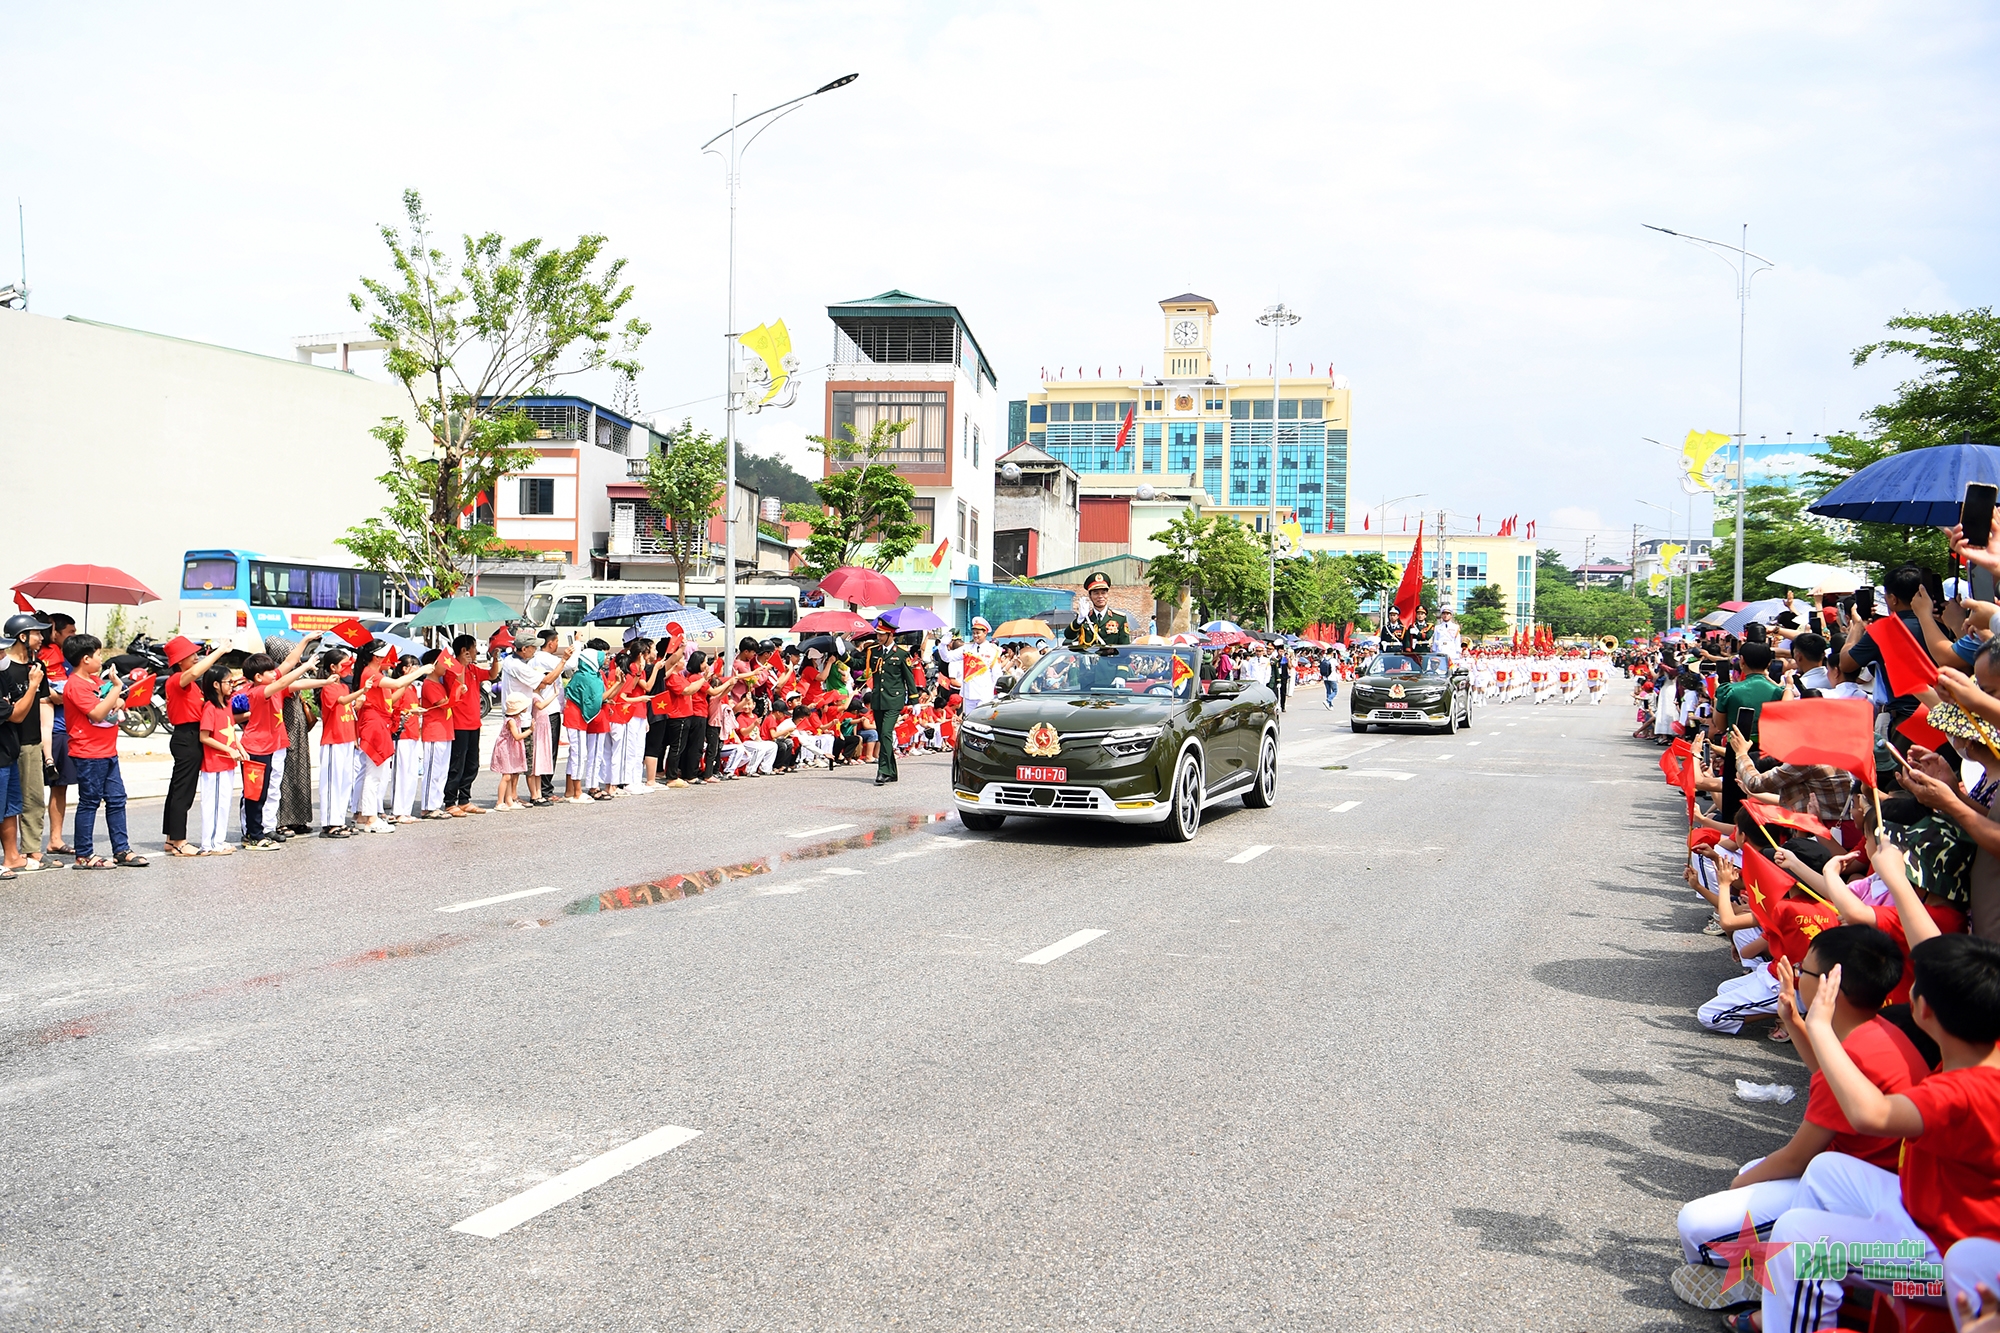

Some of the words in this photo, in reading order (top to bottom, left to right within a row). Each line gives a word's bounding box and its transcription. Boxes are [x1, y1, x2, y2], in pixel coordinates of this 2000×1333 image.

[1018, 767, 1065, 781] TM-01-70
[1795, 915, 1812, 925] Tôi
[1814, 914, 1829, 925] Yêu
